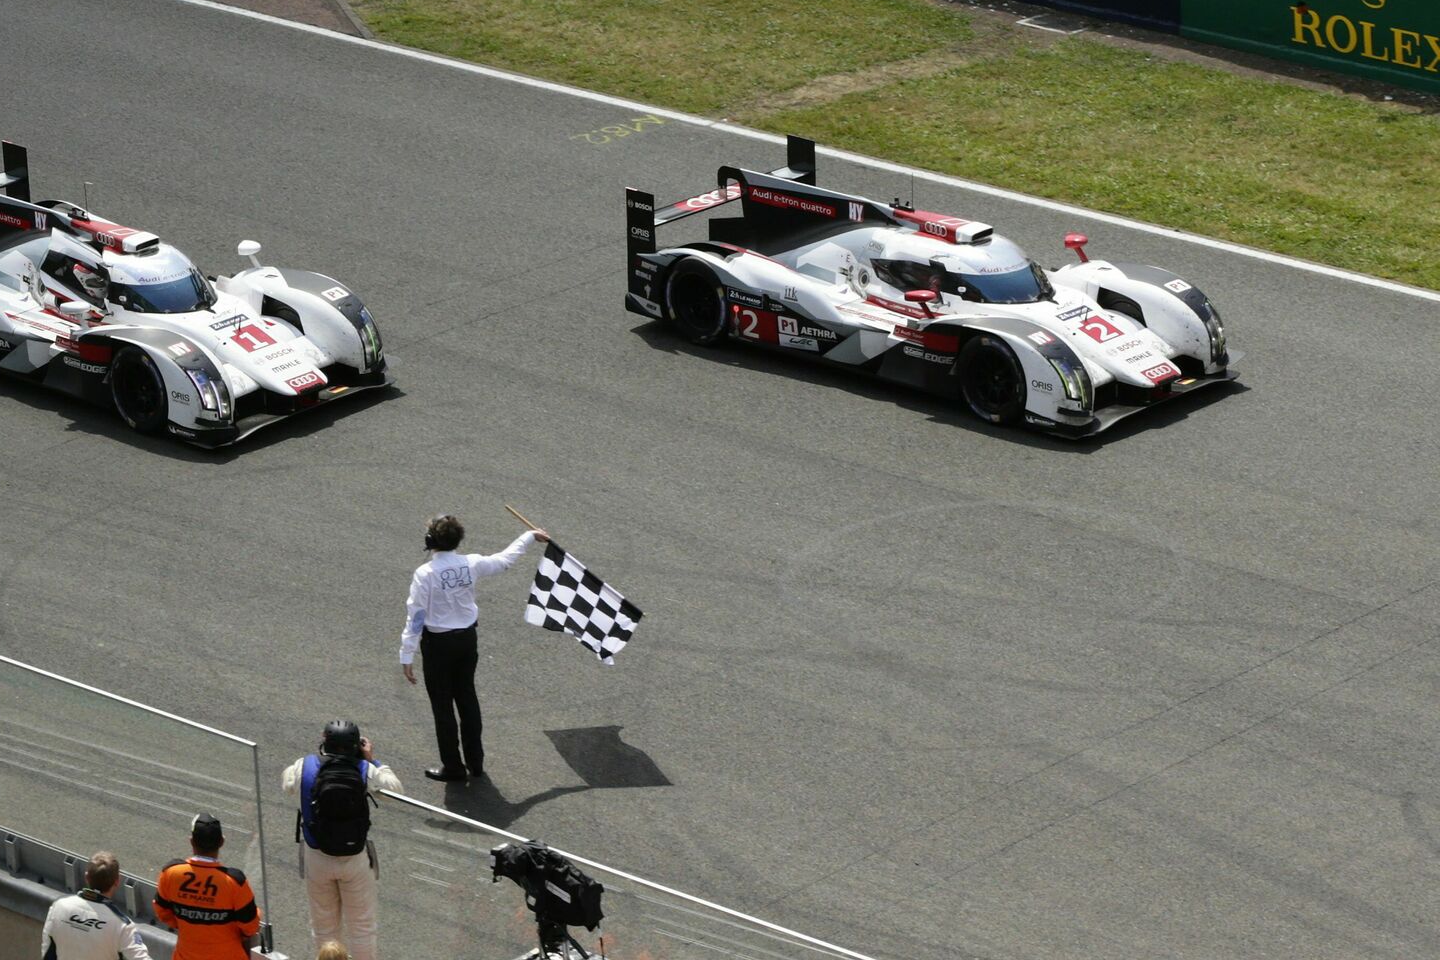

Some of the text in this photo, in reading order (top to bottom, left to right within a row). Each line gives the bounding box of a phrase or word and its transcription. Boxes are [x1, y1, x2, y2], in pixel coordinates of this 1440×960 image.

[634, 202, 653, 212] BOSCH
[752, 188, 832, 215] Audi e-tron quattro
[848, 202, 864, 222] HY
[34, 211, 48, 231] HY
[631, 226, 650, 238] ORIS
[1169, 281, 1188, 291] P1
[742, 310, 760, 339] 2
[781, 320, 795, 333] P1
[800, 326, 837, 340] AETHRA
[1084, 322, 1120, 343] 2
[239, 331, 269, 350] 1
[1116, 340, 1145, 352] BOSCH
[264, 347, 295, 361] BOSCH
[924, 353, 955, 365] EDGE
[1125, 350, 1153, 364] MAHLE
[81, 363, 109, 374] EDGE
[271, 359, 301, 374] MAHLE
[1031, 379, 1053, 391] ORIS
[171, 390, 190, 401] ORIS
[177, 871, 219, 898] 24h
[177, 892, 216, 904] LE MANS
[179, 907, 229, 922] DUNLOP
[69, 913, 107, 931] WEC
